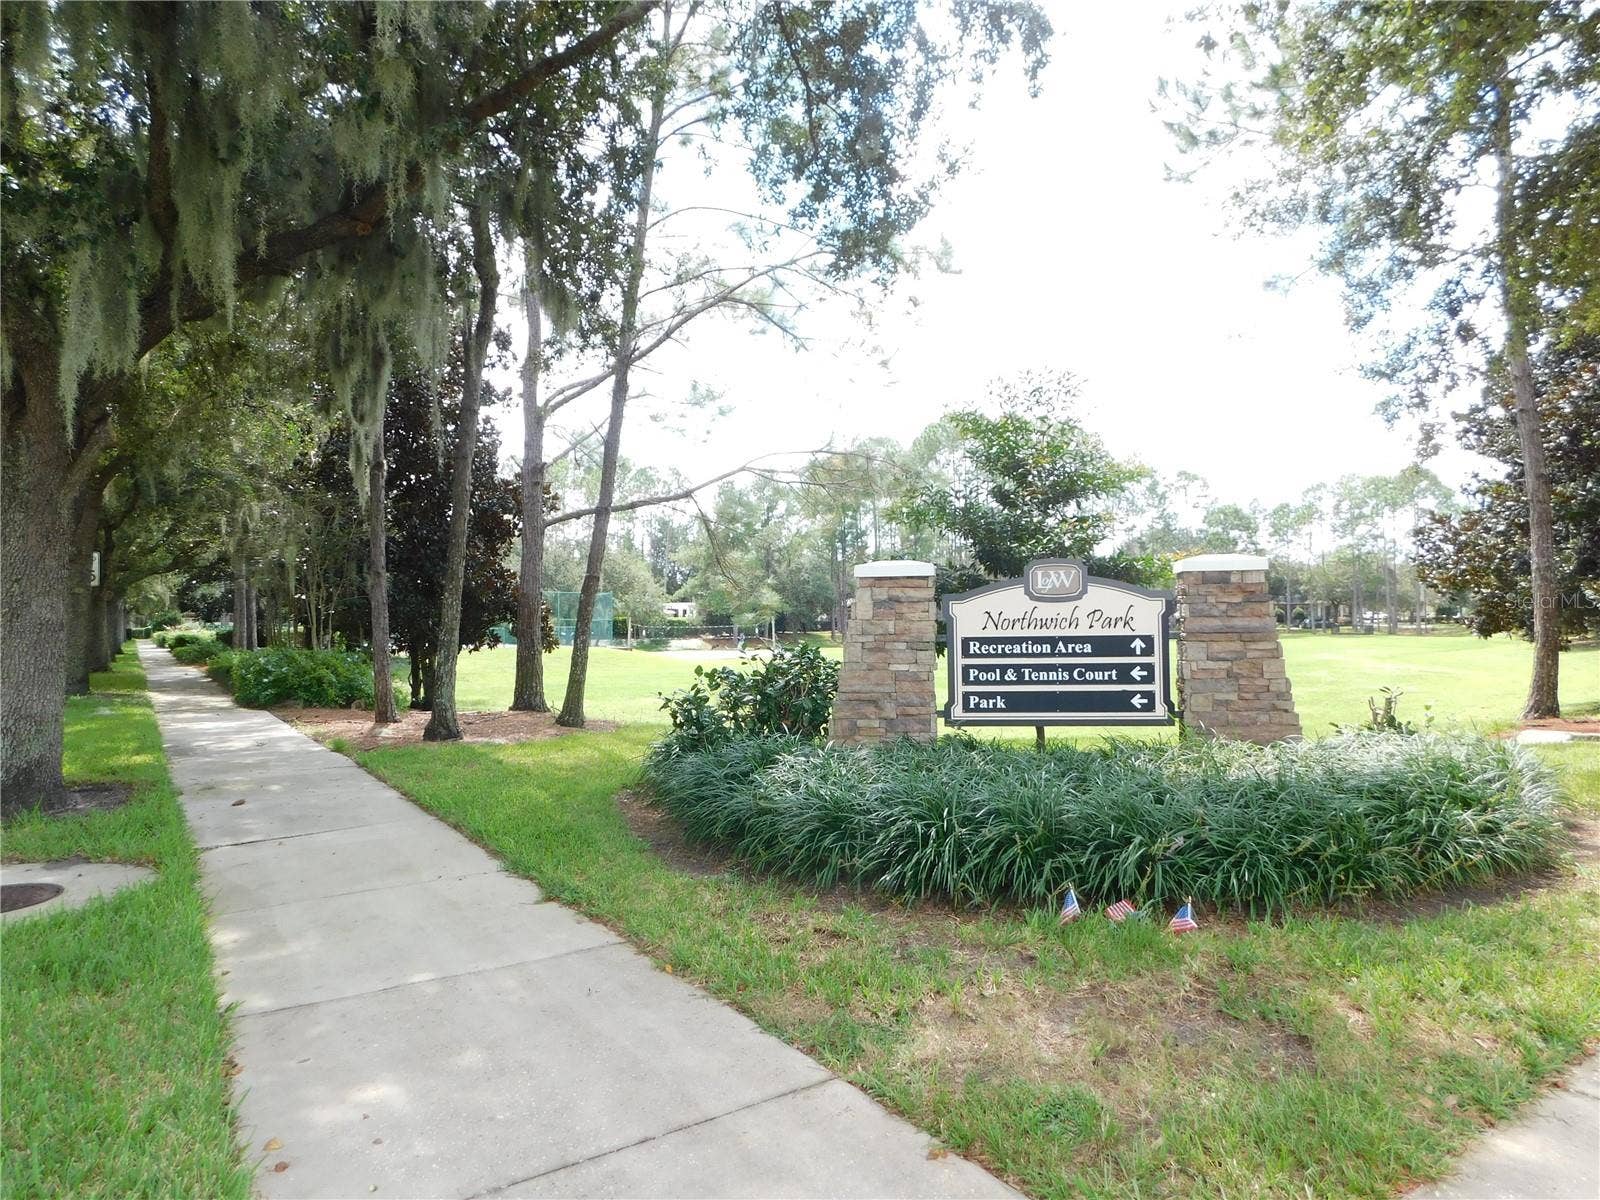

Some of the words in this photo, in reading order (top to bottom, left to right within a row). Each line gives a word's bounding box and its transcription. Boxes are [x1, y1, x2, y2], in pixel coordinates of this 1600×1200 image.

[982, 606, 1079, 632] Northwich
[1086, 604, 1137, 632] Park
[968, 641, 1051, 654] Recreation
[1054, 640, 1092, 653] Area
[968, 668, 1001, 681] Pool
[1004, 668, 1018, 681] &
[1021, 668, 1070, 681] Tennis
[1073, 668, 1118, 681] Court
[968, 696, 1007, 709] Park
